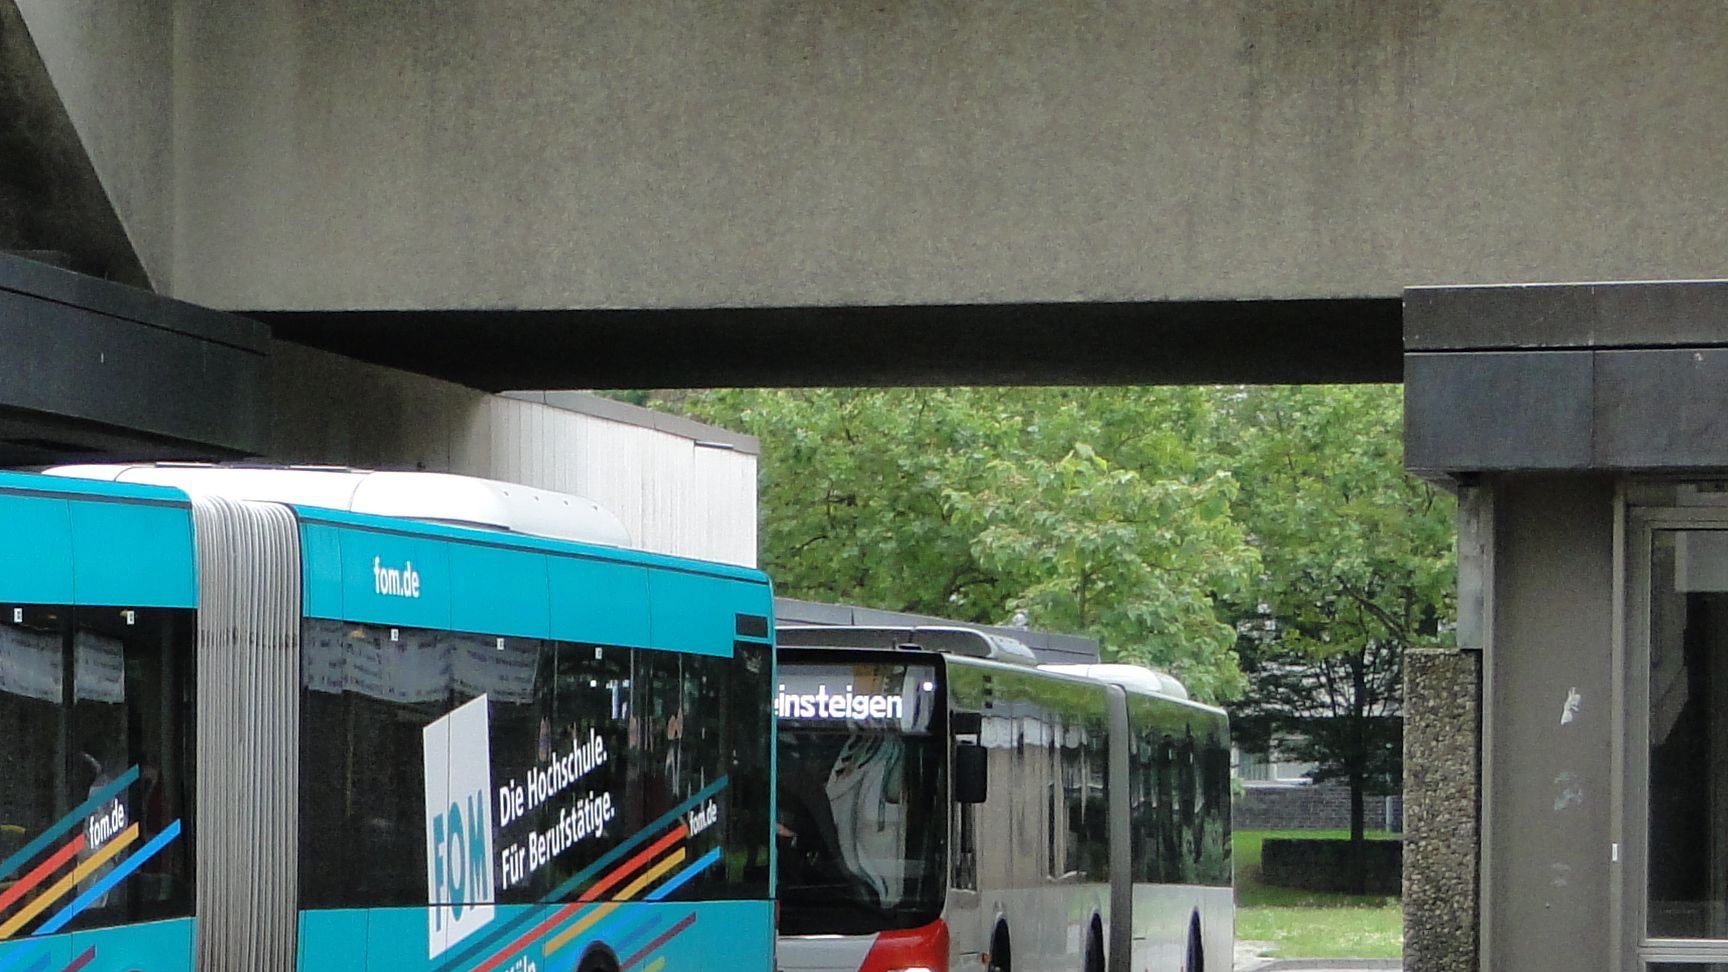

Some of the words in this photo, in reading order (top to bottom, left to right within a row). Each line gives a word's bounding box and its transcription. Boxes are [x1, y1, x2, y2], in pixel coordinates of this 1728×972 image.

[373, 555, 420, 599] fom.de
[499, 779, 524, 828] Die
[526, 727, 608, 810] Hochschule.
[88, 798, 126, 850] fom.de
[501, 841, 526, 890] Für
[528, 790, 615, 872] Berufstätige.
[688, 798, 718, 837] fom.de
[432, 789, 489, 933] FOM
